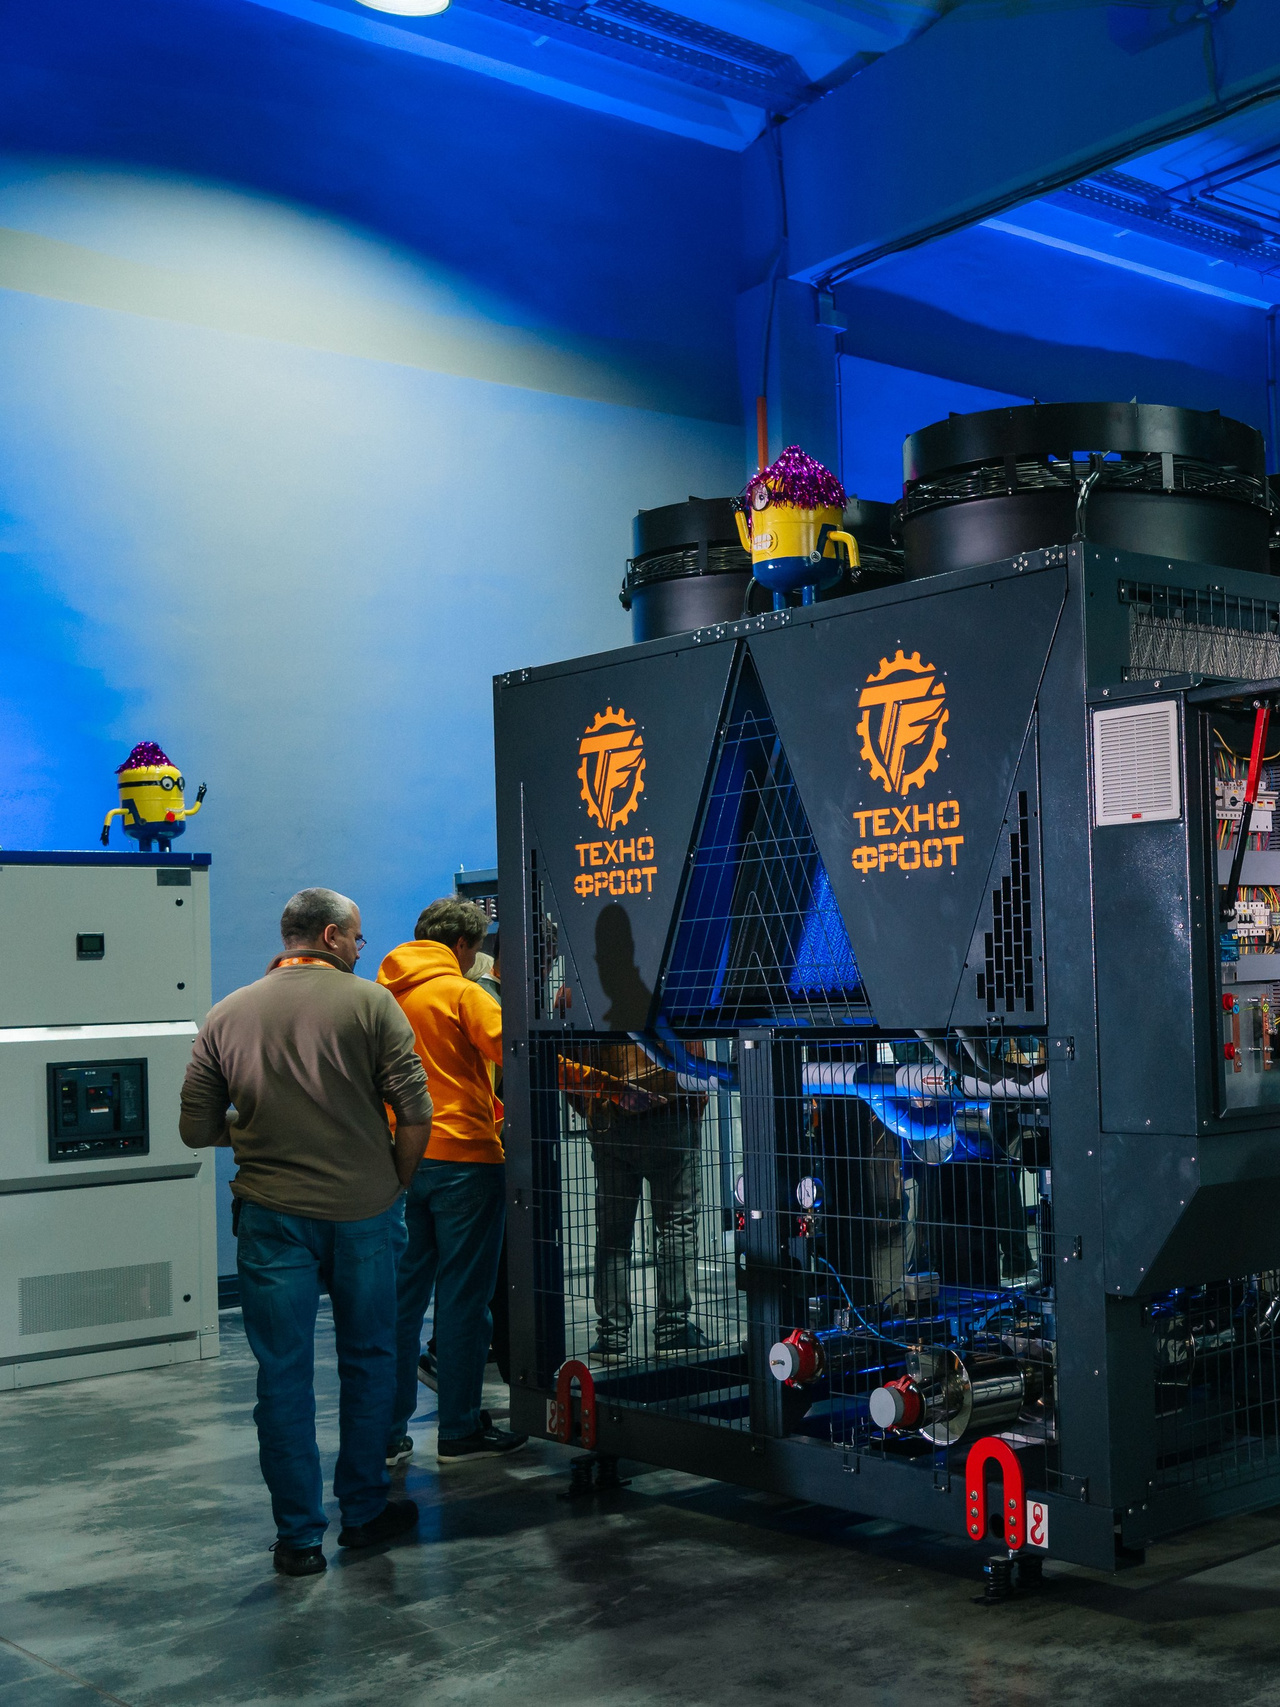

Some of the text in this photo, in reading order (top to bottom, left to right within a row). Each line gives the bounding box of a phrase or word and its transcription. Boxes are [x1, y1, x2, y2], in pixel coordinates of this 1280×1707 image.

[852, 800, 960, 838] ТЕХНО
[575, 836, 654, 867] ТЕХНО
[851, 835, 964, 874] ФРОСТ
[574, 866, 657, 898] ФРОСТ
